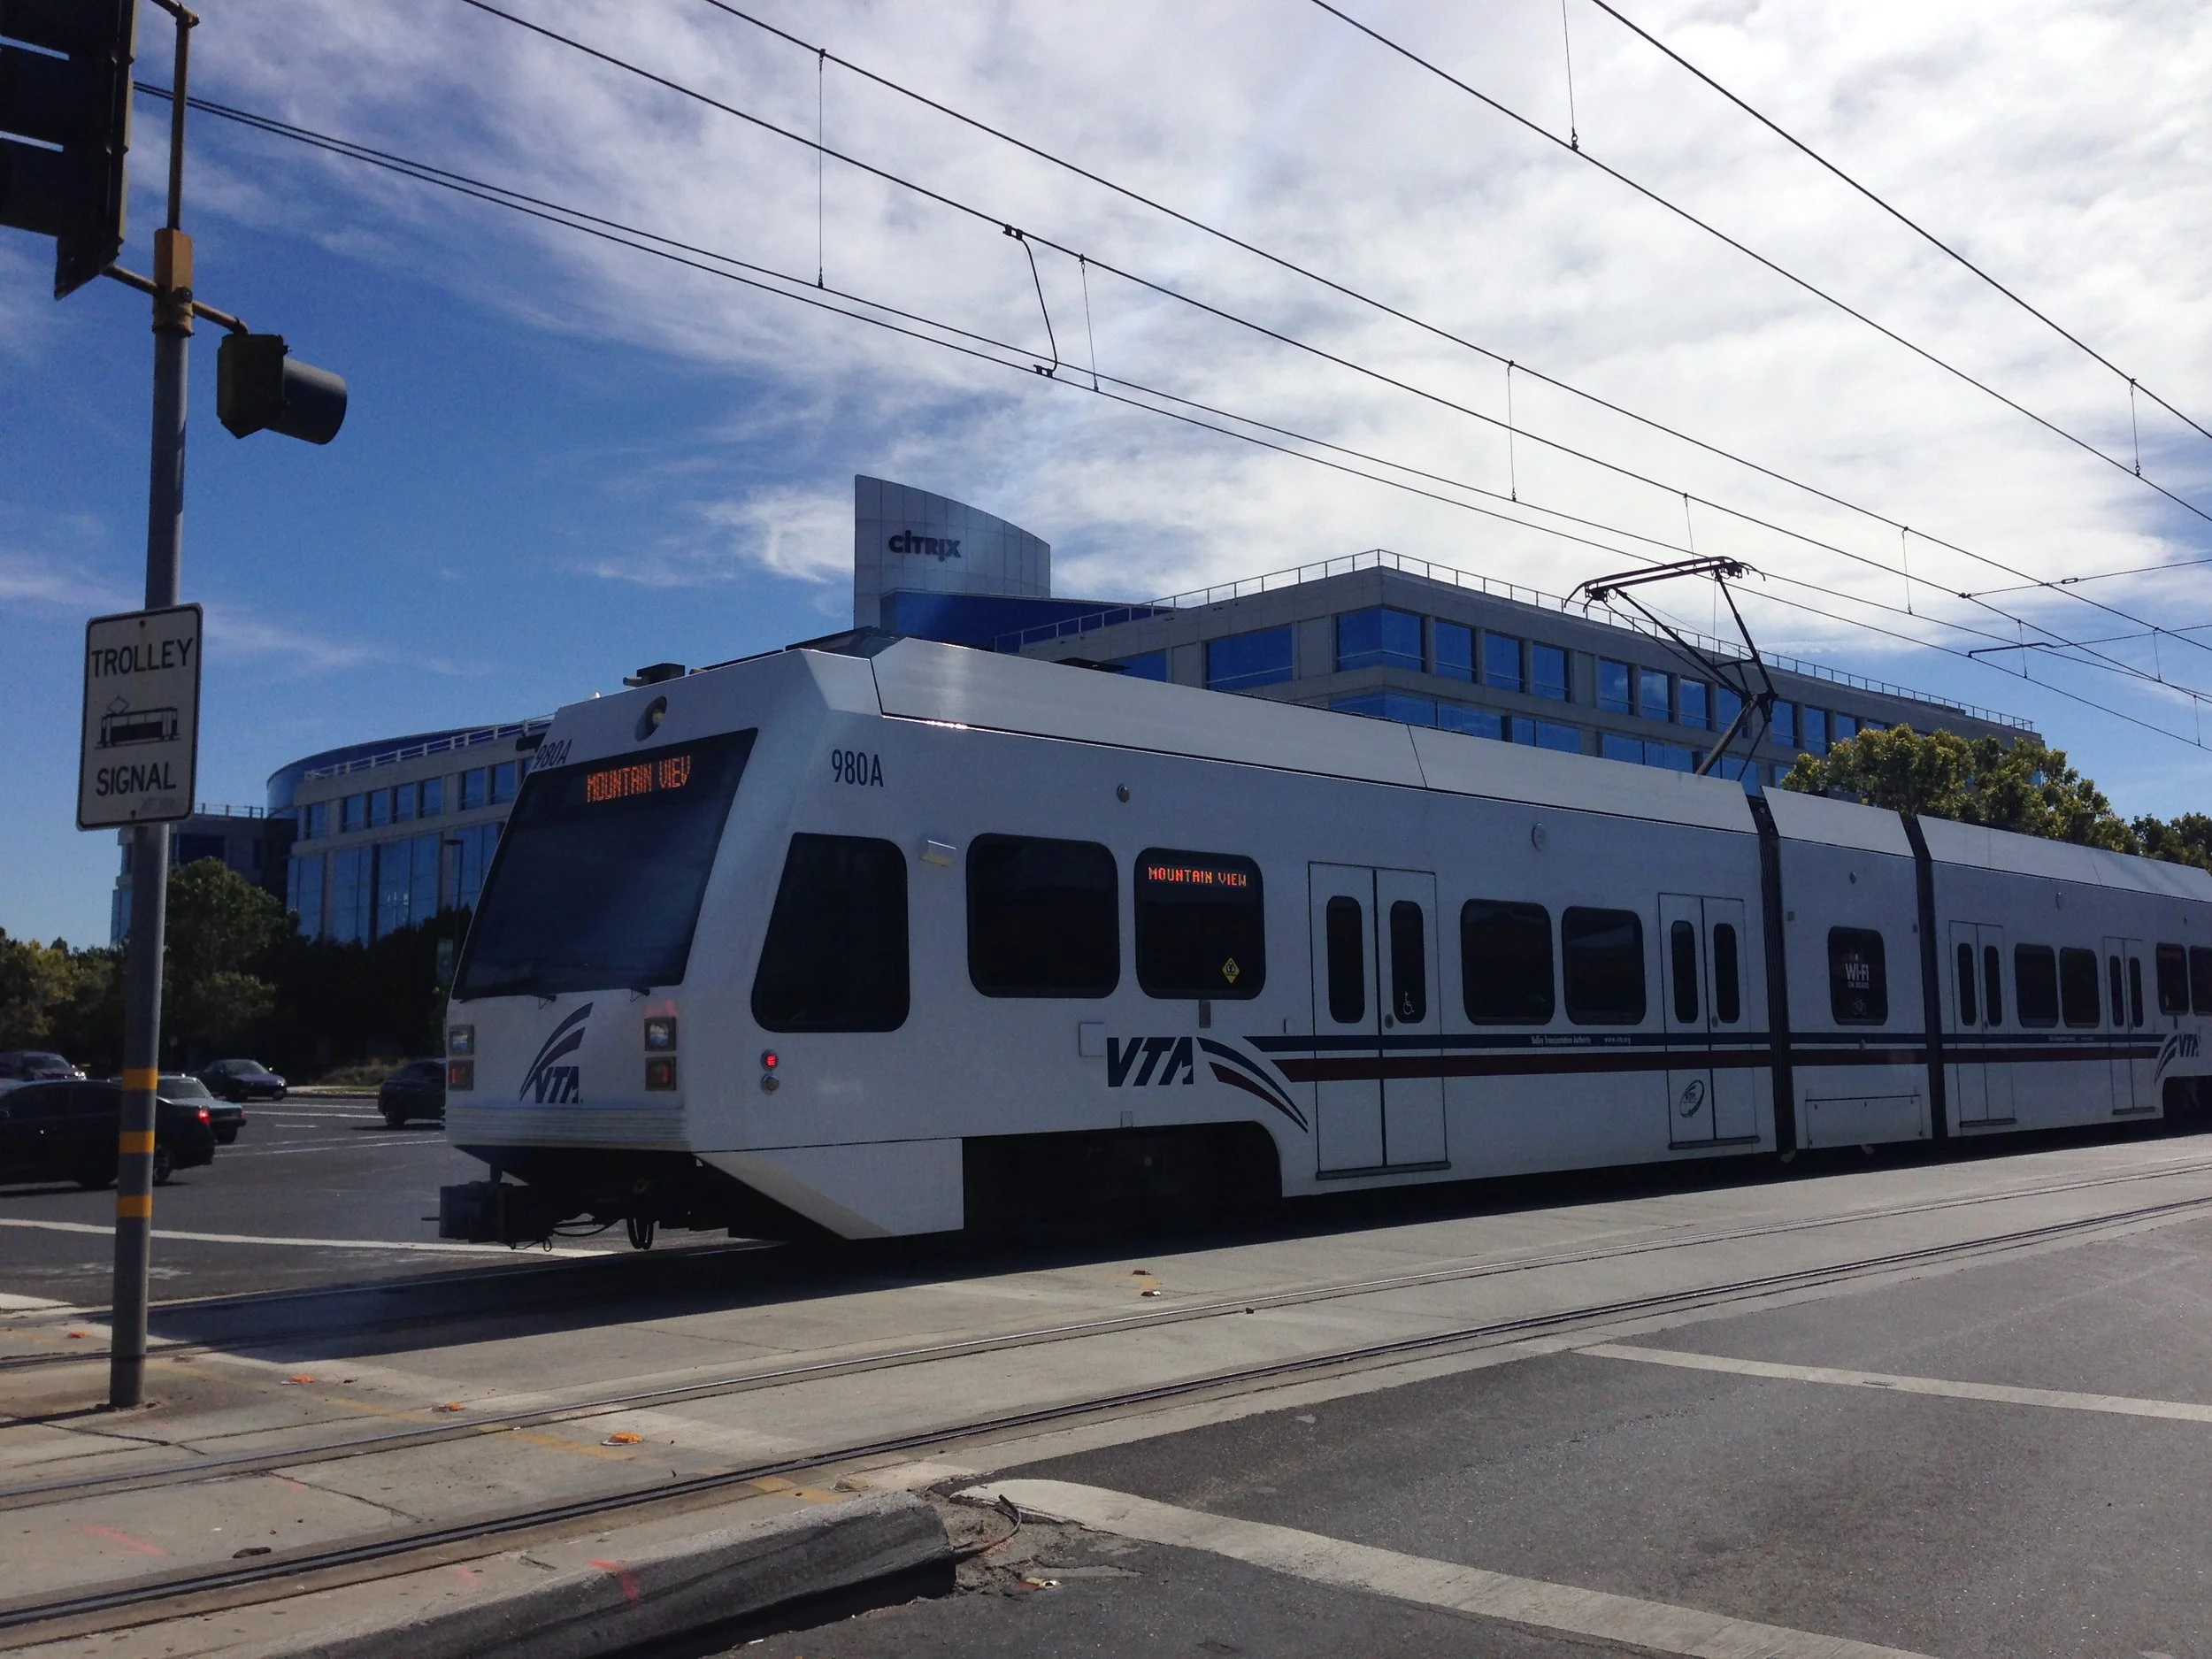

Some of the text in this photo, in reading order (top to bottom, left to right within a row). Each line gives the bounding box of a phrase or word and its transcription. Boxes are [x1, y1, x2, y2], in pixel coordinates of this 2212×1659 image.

[91, 637, 194, 678] TROLLEY
[533, 739, 572, 770] 980A
[832, 749, 884, 787] 980A
[96, 761, 176, 796] SIGNAL
[587, 763, 652, 803] MOUNTAIN
[1148, 866, 1247, 887] MOUNTAIN VIEW
[1106, 1036, 1194, 1087] VTA
[2179, 1033, 2200, 1057] VTA
[534, 1065, 580, 1104] VTA
